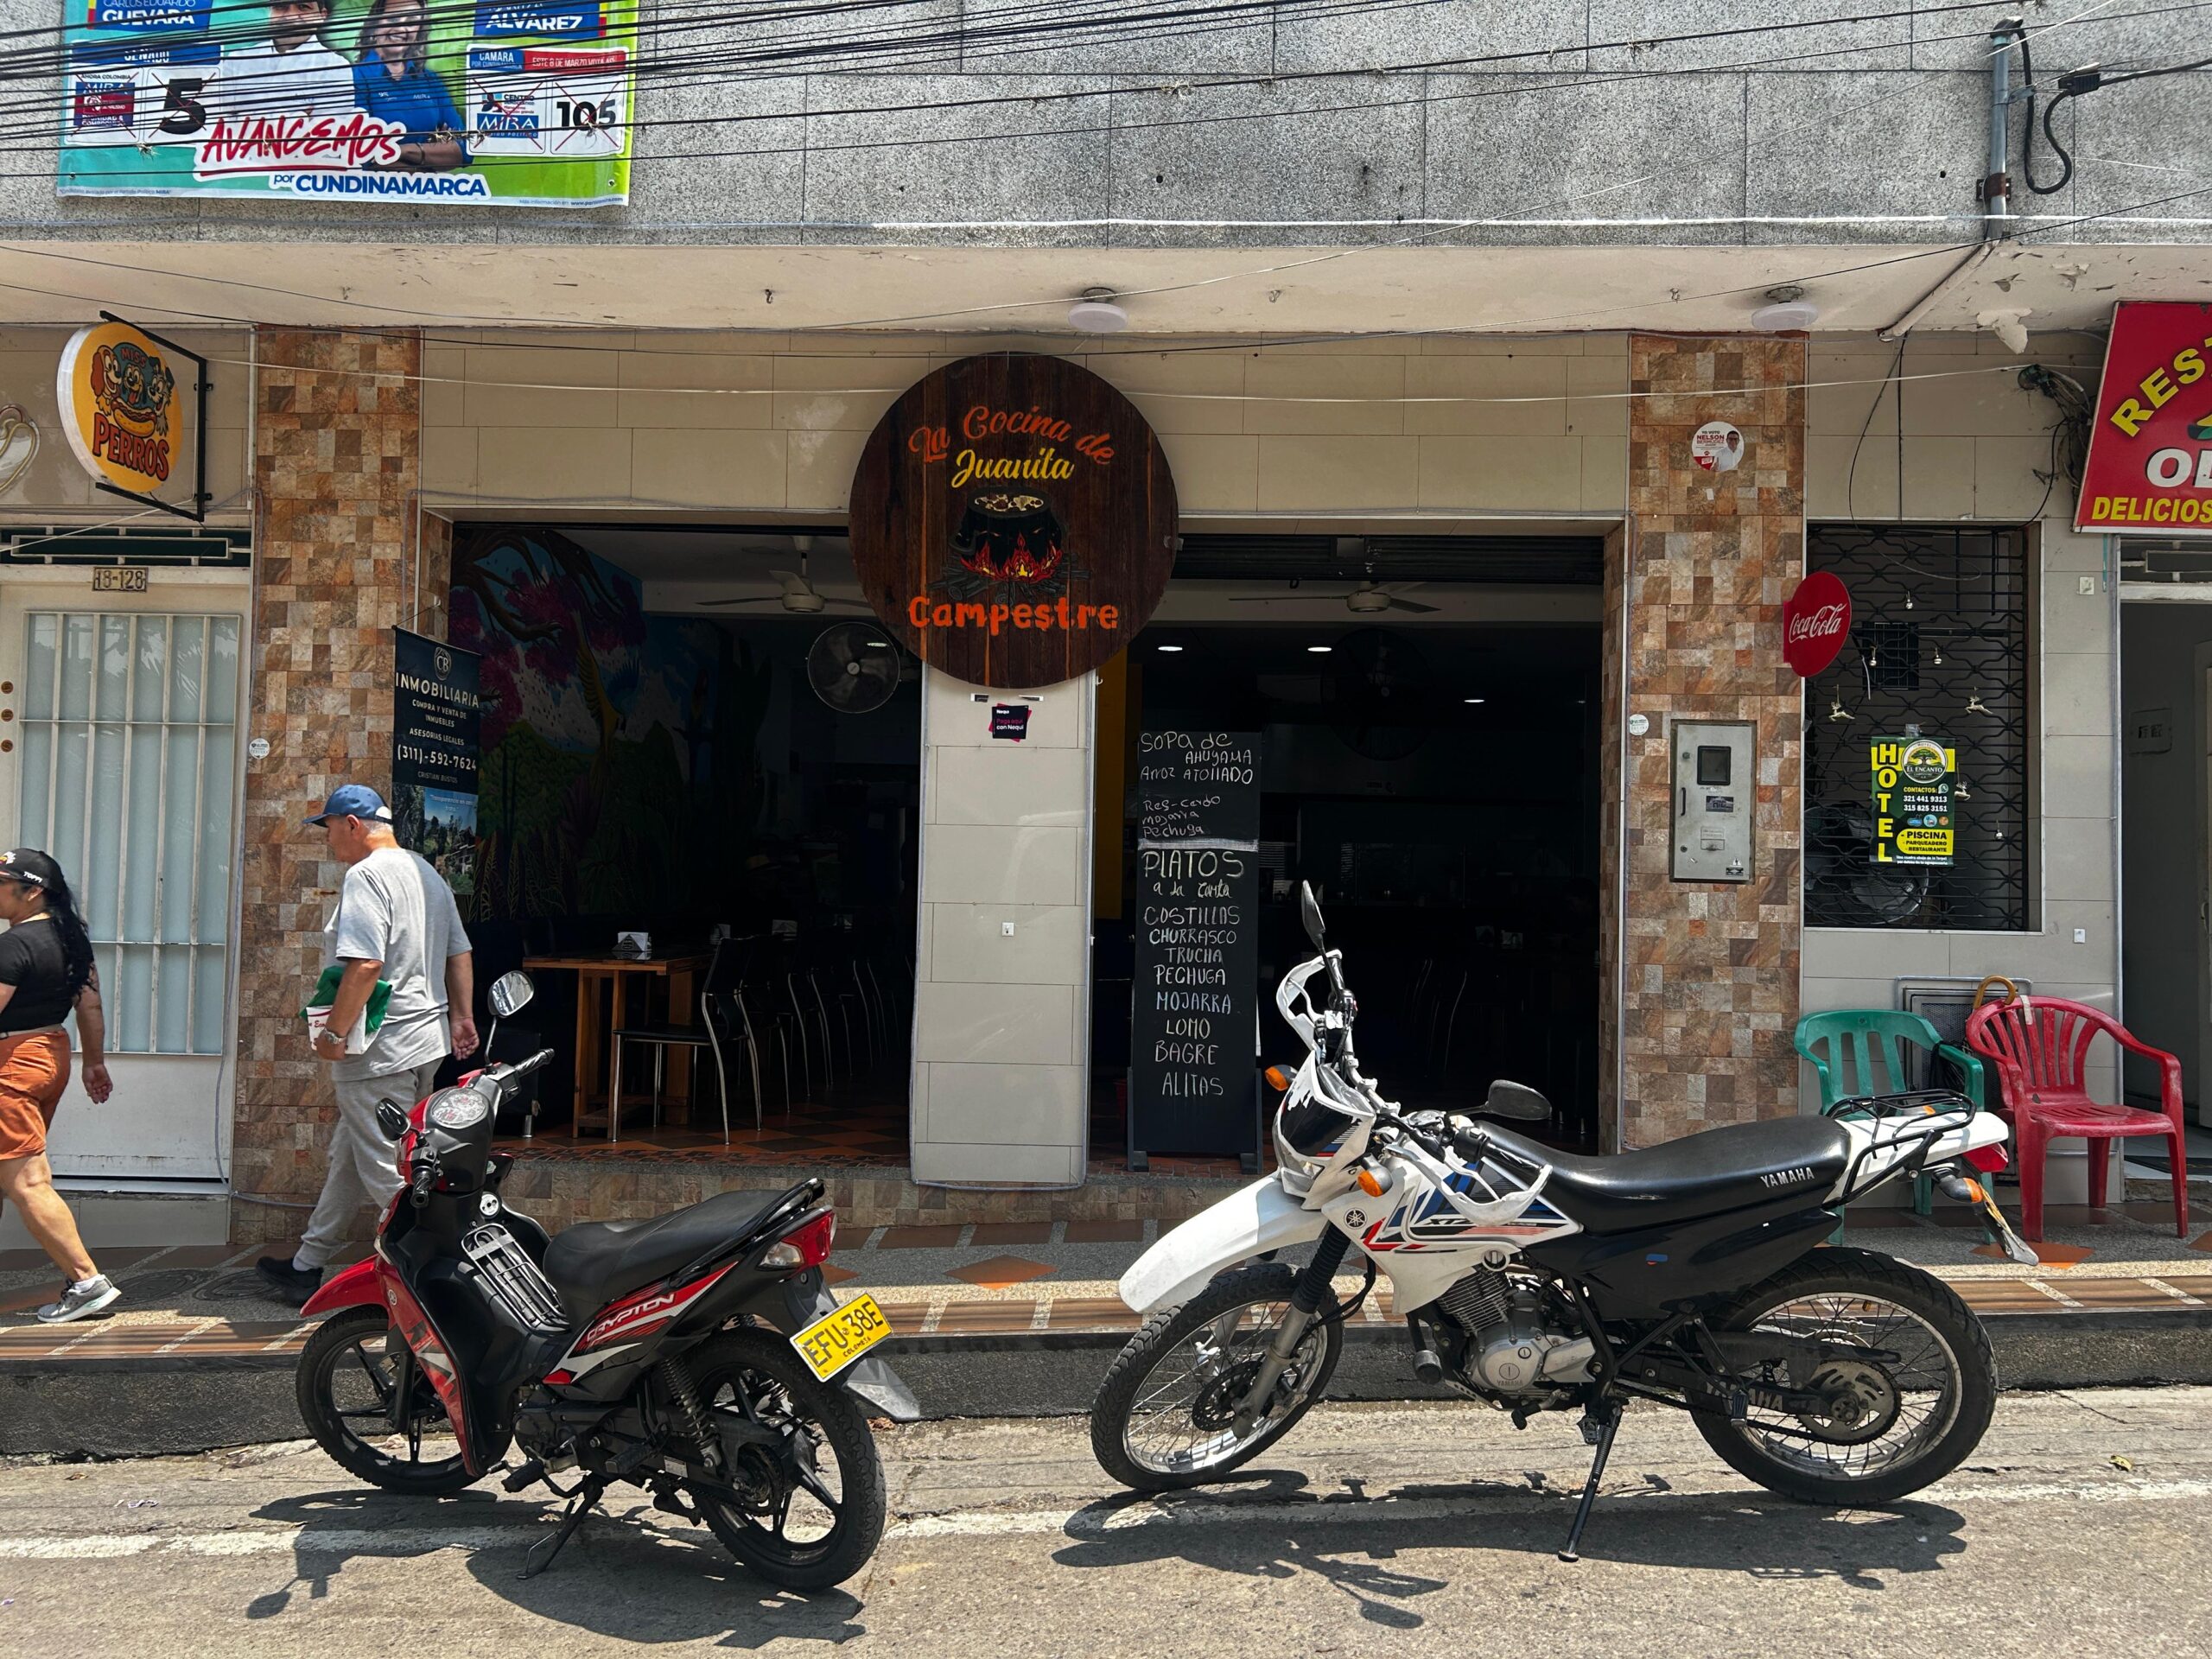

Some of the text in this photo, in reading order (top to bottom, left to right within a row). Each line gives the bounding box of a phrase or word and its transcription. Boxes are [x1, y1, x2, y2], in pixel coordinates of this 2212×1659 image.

[102, 10, 195, 25] GUEVARA
[159, 78, 206, 135] 5
[556, 99, 616, 131] 105
[480, 116, 536, 130] MIRA
[202, 113, 404, 166] AVANCEMOS
[273, 175, 486, 196] por CUNDINAMARCA
[121, 347, 146, 369] MISS
[92, 412, 169, 481] PERROS
[908, 405, 1116, 465] La Cocina de
[951, 447, 1074, 488] Juanita
[908, 595, 1119, 636] Campestre
[1789, 603, 1847, 644] Coca-Cola
[396, 672, 480, 708] INMOBILIARIA
[412, 699, 435, 711] COMPRA
[442, 706, 459, 718] VENTA
[460, 710, 467, 720] DE
[425, 714, 455, 728] INMUEBLES
[1877, 743, 1897, 862] HOTEL
[1143, 906, 1241, 925] COSTILLAS
[1148, 927, 1237, 946] CHURRASCO
[1164, 947, 1223, 964] TRUCHA
[1154, 963, 1226, 986] PECHUGA
[1156, 991, 1231, 1014] MOJARRA
[1166, 1018, 1211, 1039] LOMO
[1154, 1039, 1220, 1065] BAGRE
[1162, 1071, 1224, 1097] ALITAS
[1760, 1166, 1815, 1189] YAMAHA
[588, 1294, 674, 1343] CRYPTON
[803, 1301, 884, 1367] EFU 38E
[842, 1336, 872, 1357] COLOMBIA
